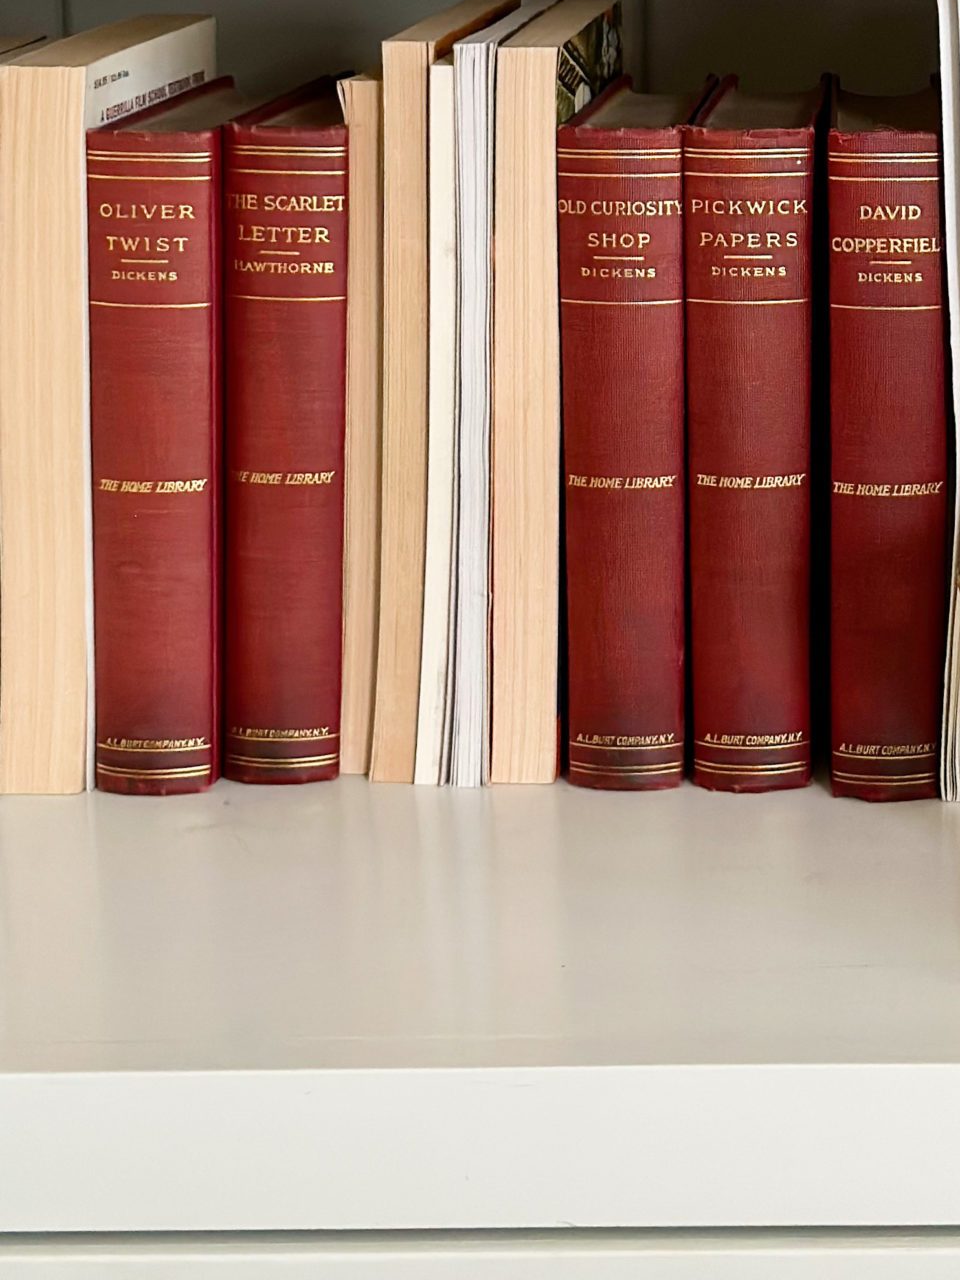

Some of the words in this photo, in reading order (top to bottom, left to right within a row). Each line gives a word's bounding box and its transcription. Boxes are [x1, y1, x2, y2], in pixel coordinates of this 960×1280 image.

[226, 194, 258, 210] THE
[264, 195, 345, 211] SCARLET
[558, 199, 587, 214] OLD
[591, 200, 682, 216] CURIOSITY
[691, 199, 808, 215] PICKWICK
[100, 203, 196, 219] OLIVER
[859, 205, 921, 220] DAVID
[239, 224, 330, 243] LETTER
[587, 233, 651, 248] SHOP
[699, 232, 799, 248] PAPERS
[106, 236, 189, 252] TWIST
[832, 237, 941, 253] COPPERFIEL
[234, 259, 335, 274] HAWTHORNE
[581, 267, 656, 278] DICKENS
[711, 266, 787, 277] DICKENS
[111, 271, 177, 281] DICKENS
[857, 272, 923, 283] DICKENS
[99, 479, 120, 491] THE
[120, 481, 153, 493] HOME
[155, 478, 208, 493] LIBRARY
[250, 472, 282, 485] HOME
[285, 471, 335, 485] LIBRARY
[568, 474, 588, 487] THE
[589, 477, 623, 488] HOME
[624, 475, 677, 489] LIBRARY
[697, 474, 717, 486] THE
[719, 476, 753, 488] HOME
[754, 473, 806, 489] LIBRARY
[833, 481, 855, 494] THE
[856, 484, 891, 496] HOME
[892, 481, 943, 496] LIBRARY
